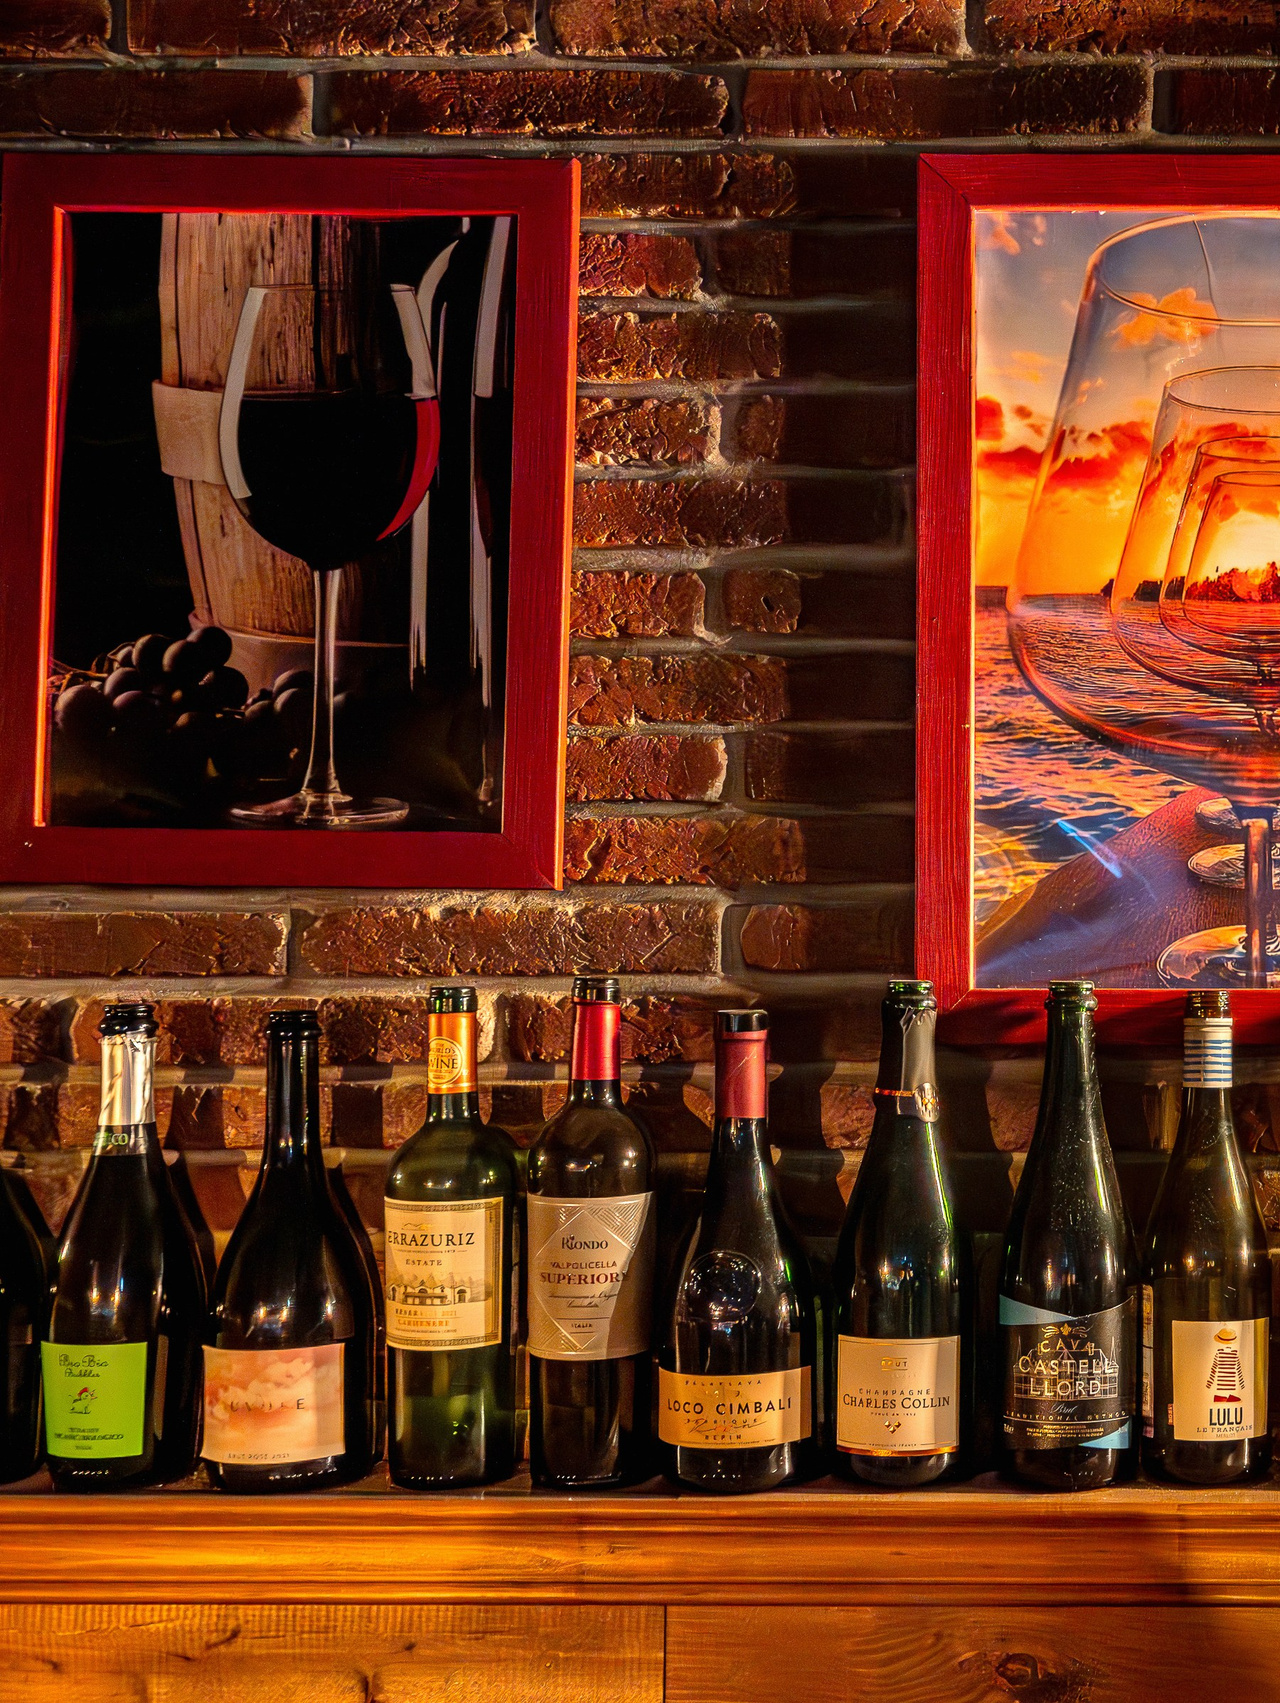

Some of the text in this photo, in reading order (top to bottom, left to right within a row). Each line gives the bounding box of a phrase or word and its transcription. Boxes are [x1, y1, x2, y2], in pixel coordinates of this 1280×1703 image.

[387, 1230, 475, 1248] ERRAZURIZ
[405, 1258, 443, 1267] ESTATE
[550, 1260, 618, 1270] VALPOLICELLA
[1040, 1338, 1095, 1352] CAVA
[1018, 1355, 1115, 1375] CASTELL
[858, 1387, 931, 1397] CHAMPAGNE
[1030, 1377, 1102, 1396] LLORD
[667, 1397, 792, 1415] LOCO CIMBALI
[842, 1393, 951, 1409] CHARLES COLLIN
[1050, 1402, 1079, 1414] Brut
[1209, 1407, 1243, 1426] LULU
[1211, 1424, 1253, 1433] FRANÇAIS
